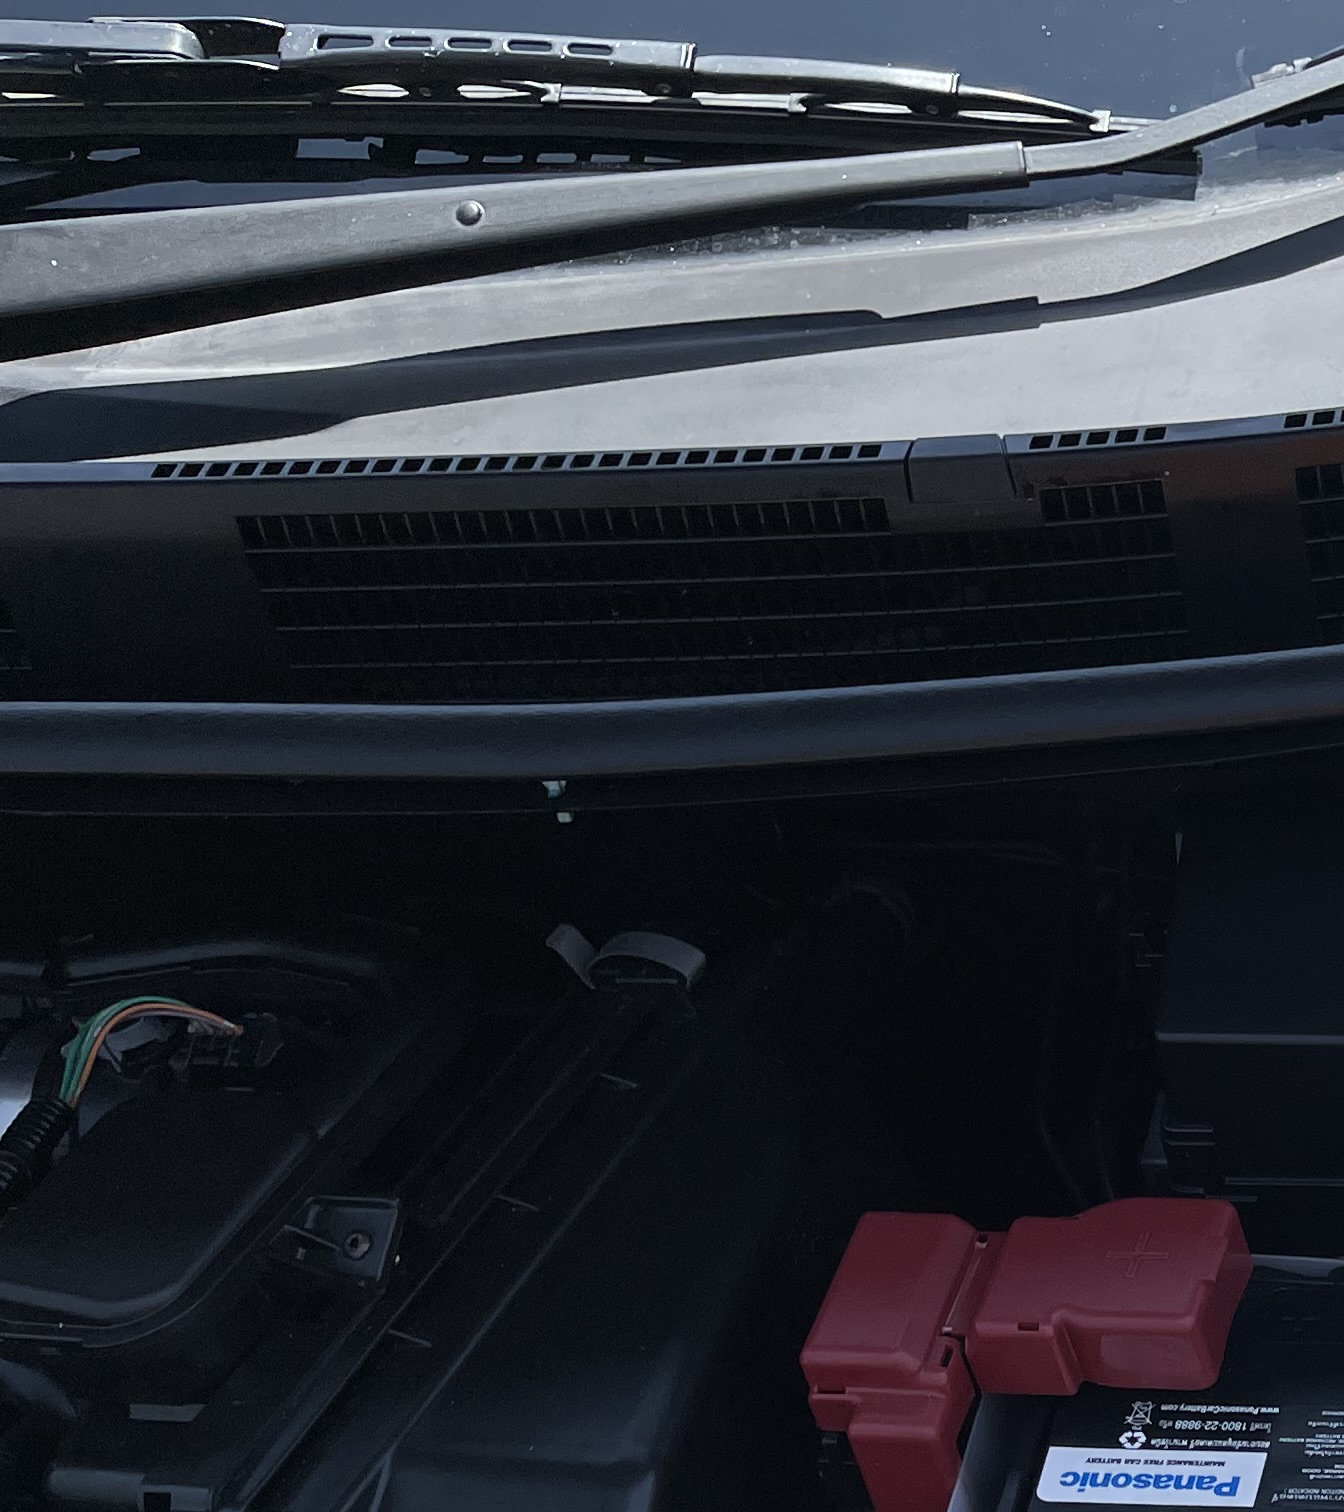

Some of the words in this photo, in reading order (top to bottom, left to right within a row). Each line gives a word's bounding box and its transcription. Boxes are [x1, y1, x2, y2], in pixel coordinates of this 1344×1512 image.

[1160, 1403, 1281, 1415] www.PanasonicCarBattery.com
[1174, 1420, 1247, 1432] 1800-22-9888
[1085, 1456, 1122, 1465] BATTERY
[1123, 1457, 1142, 1466] CAR
[1143, 1458, 1165, 1466] FREE
[1165, 1458, 1226, 1468] MAINTENANCE
[1058, 1470, 1241, 1498] Panasonic
